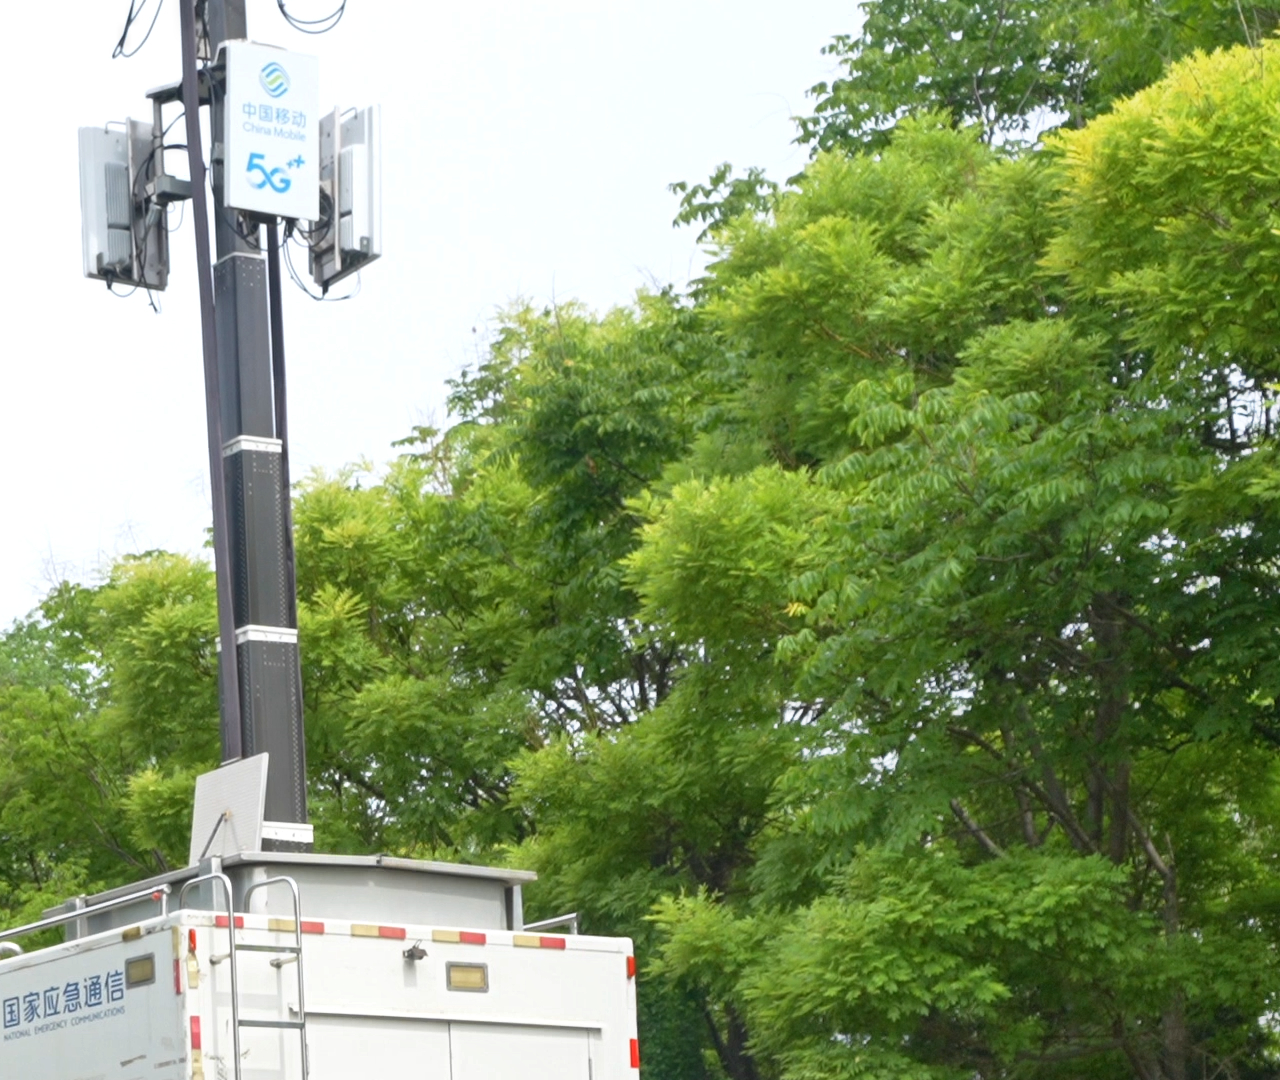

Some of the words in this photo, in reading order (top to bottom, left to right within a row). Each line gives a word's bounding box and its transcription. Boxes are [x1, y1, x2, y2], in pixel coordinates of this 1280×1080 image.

[242, 102, 306, 128] 中国移动
[242, 121, 272, 136] China
[274, 126, 306, 142] Mobile
[3, 969, 124, 1029] 国家应急通信
[3, 1028, 31, 1041] NATIONAL
